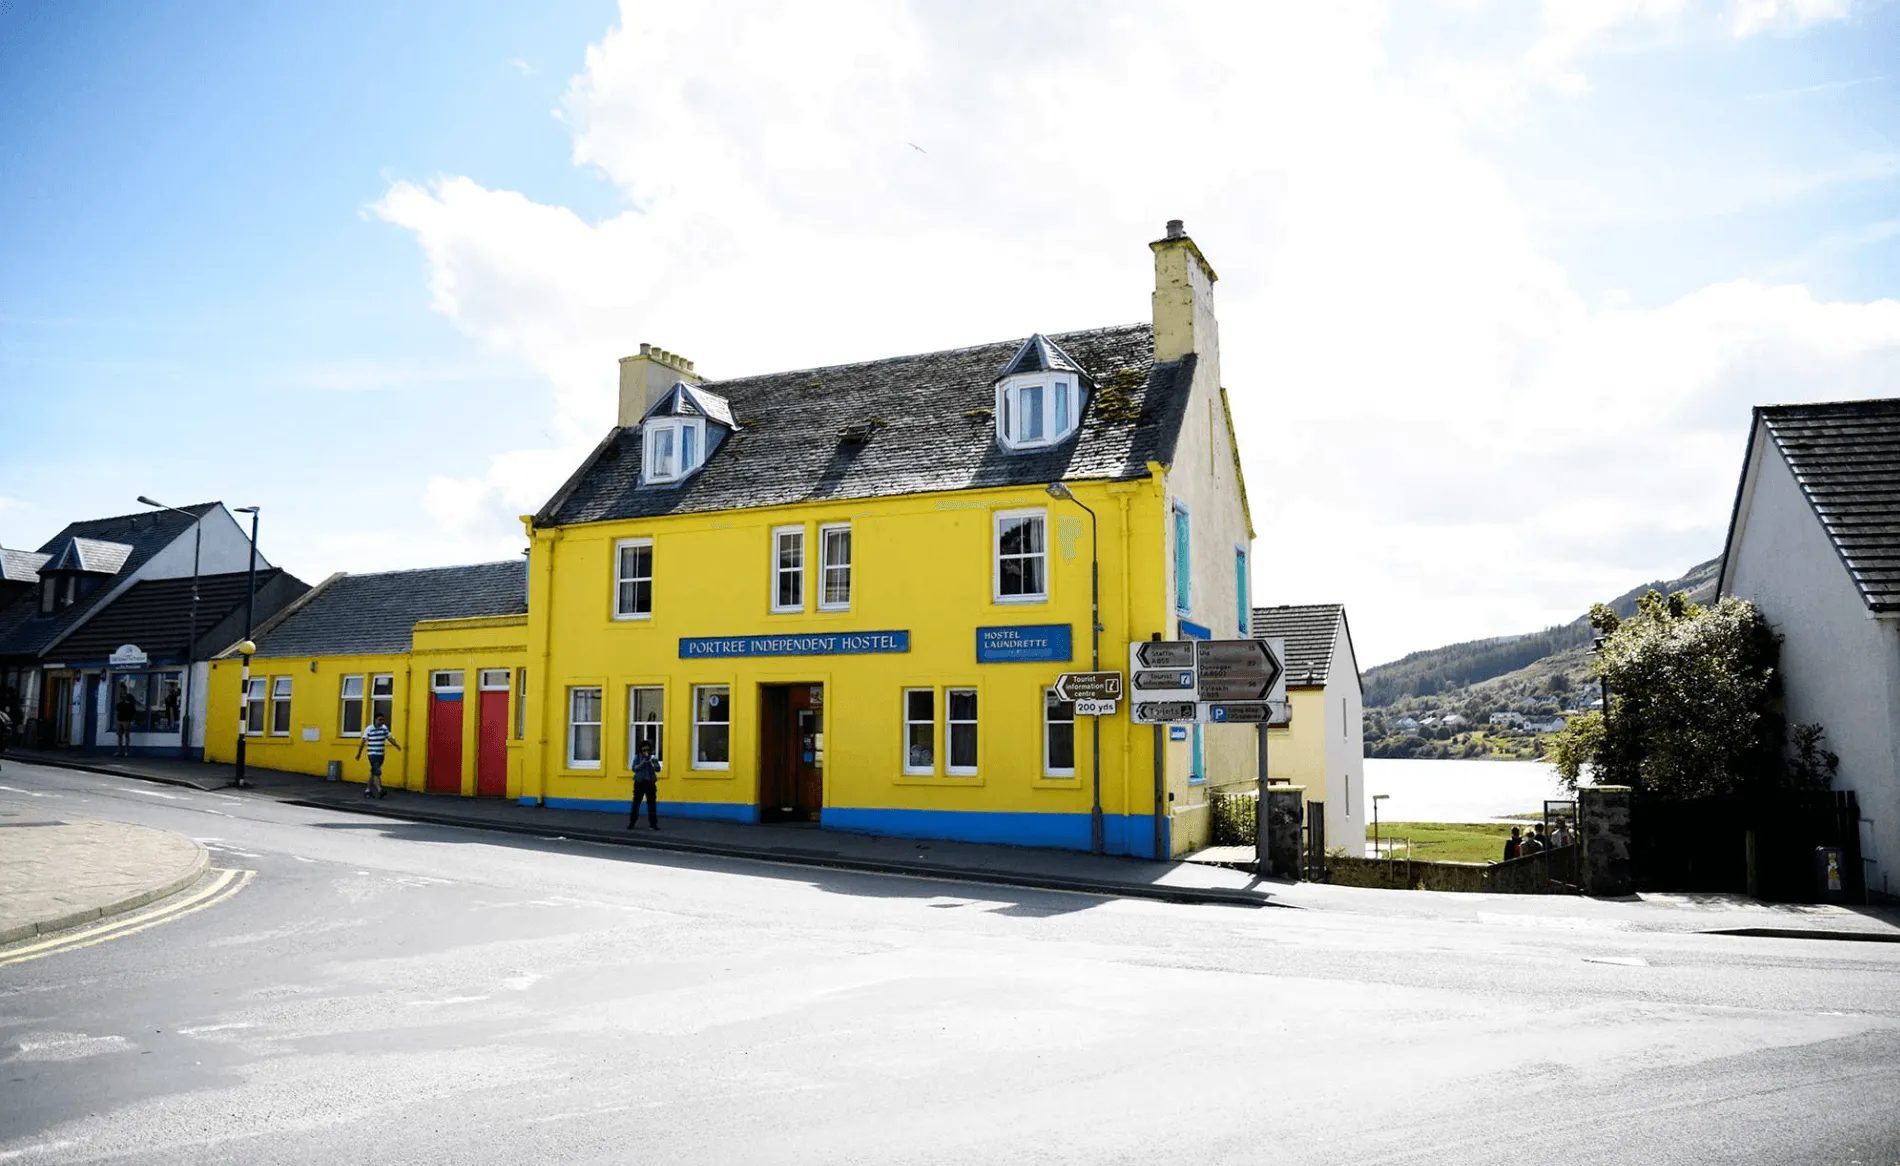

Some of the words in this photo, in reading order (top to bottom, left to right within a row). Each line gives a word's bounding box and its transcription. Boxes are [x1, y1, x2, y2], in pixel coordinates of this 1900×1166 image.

[984, 631, 1020, 640] HOSTEL
[689, 640, 745, 654] PORTREE
[751, 637, 836, 653] INDEPENDENT
[842, 635, 897, 649] HOSTEL
[984, 639, 1049, 649] LAUNDRETTE
[1078, 703, 1096, 711] 200
[1098, 703, 1114, 712] yds
[1215, 708, 1223, 719] P
